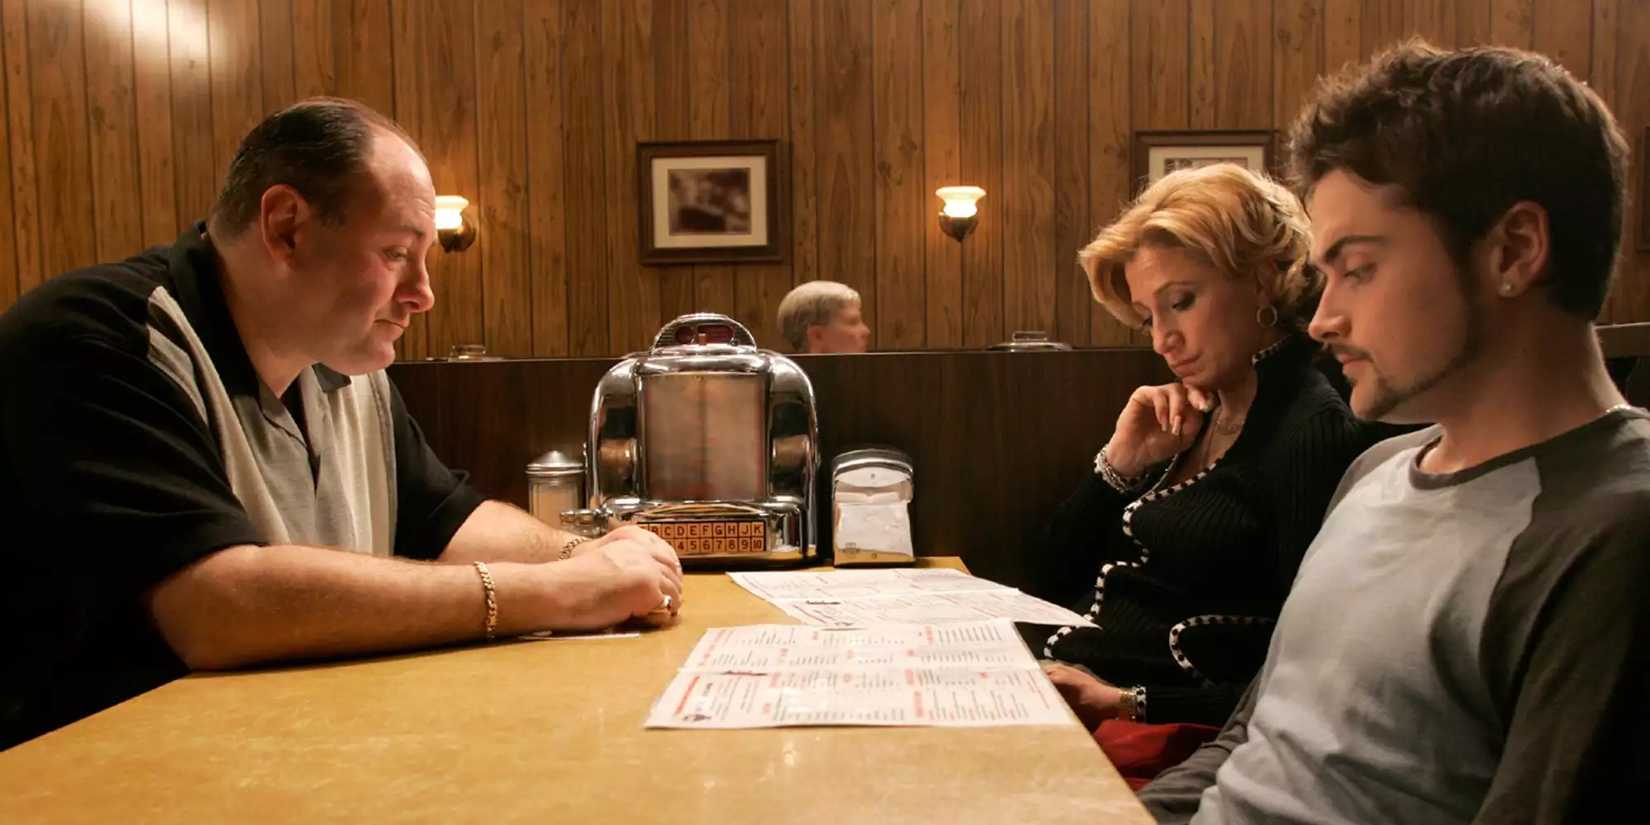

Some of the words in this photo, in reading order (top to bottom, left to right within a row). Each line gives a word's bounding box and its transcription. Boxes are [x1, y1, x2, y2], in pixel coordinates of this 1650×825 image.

[664, 526, 671, 536] C
[676, 526, 685, 536] D
[690, 525, 697, 536] E
[702, 525, 709, 535] F
[715, 525, 722, 535] G
[727, 525, 736, 535] H
[741, 524, 749, 535] J
[753, 525, 761, 534] K
[677, 541, 684, 550] 4
[690, 540, 697, 550] 5
[703, 540, 710, 550] 6
[715, 540, 722, 550] 7
[728, 539, 736, 550] 8
[741, 539, 749, 550] 9
[753, 539, 762, 549] 10
